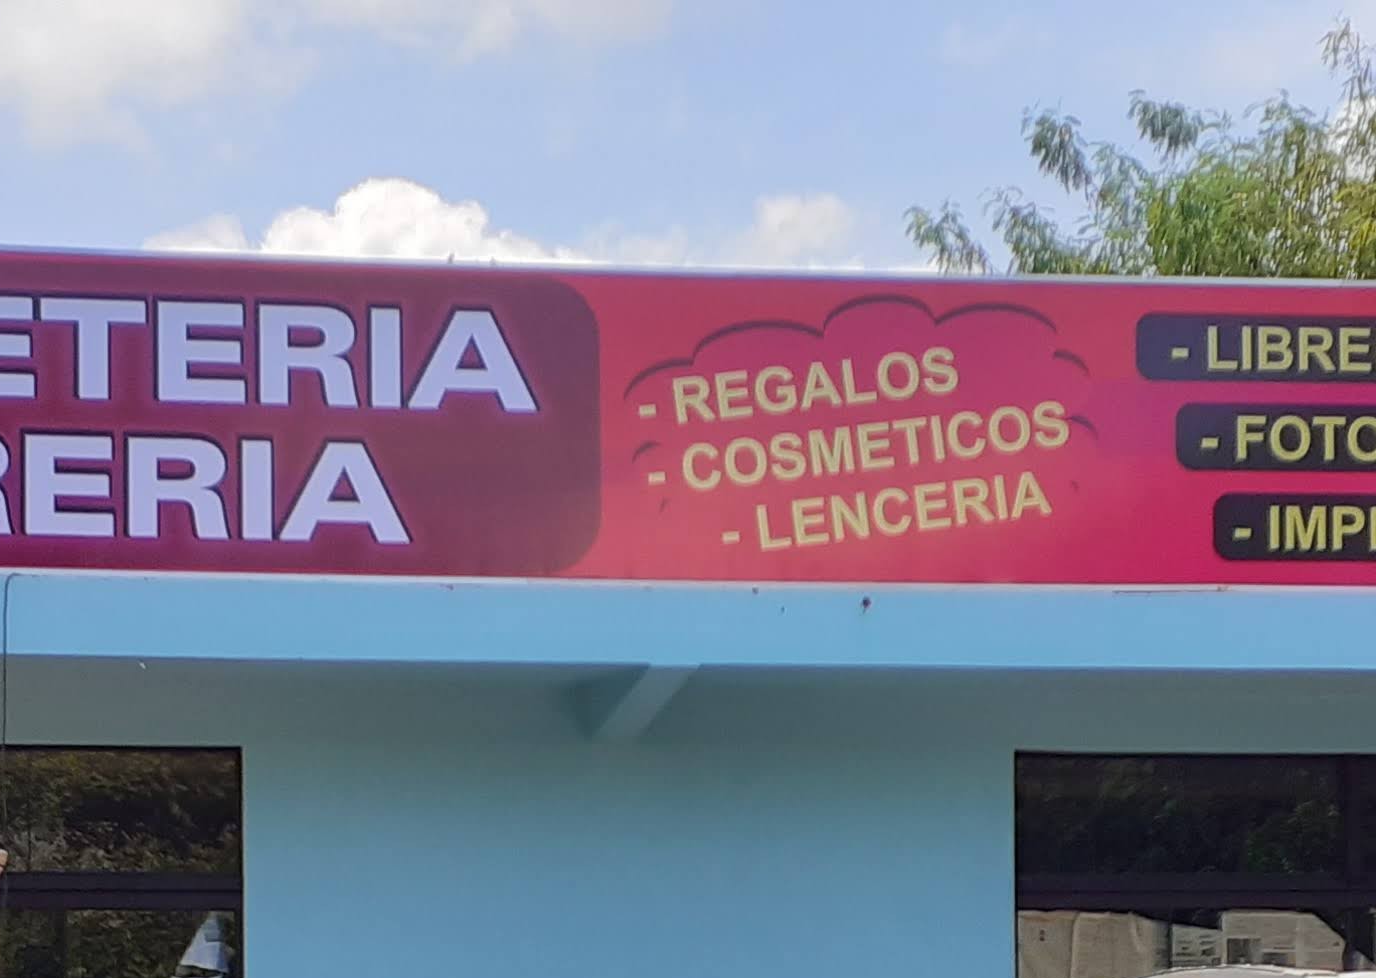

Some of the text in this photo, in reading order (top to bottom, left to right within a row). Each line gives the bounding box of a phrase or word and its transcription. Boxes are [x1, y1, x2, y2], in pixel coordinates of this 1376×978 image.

[672, 347, 959, 424] REGALOS
[681, 400, 1070, 489] COSMETICOS
[755, 471, 1052, 551] LENCERIA
